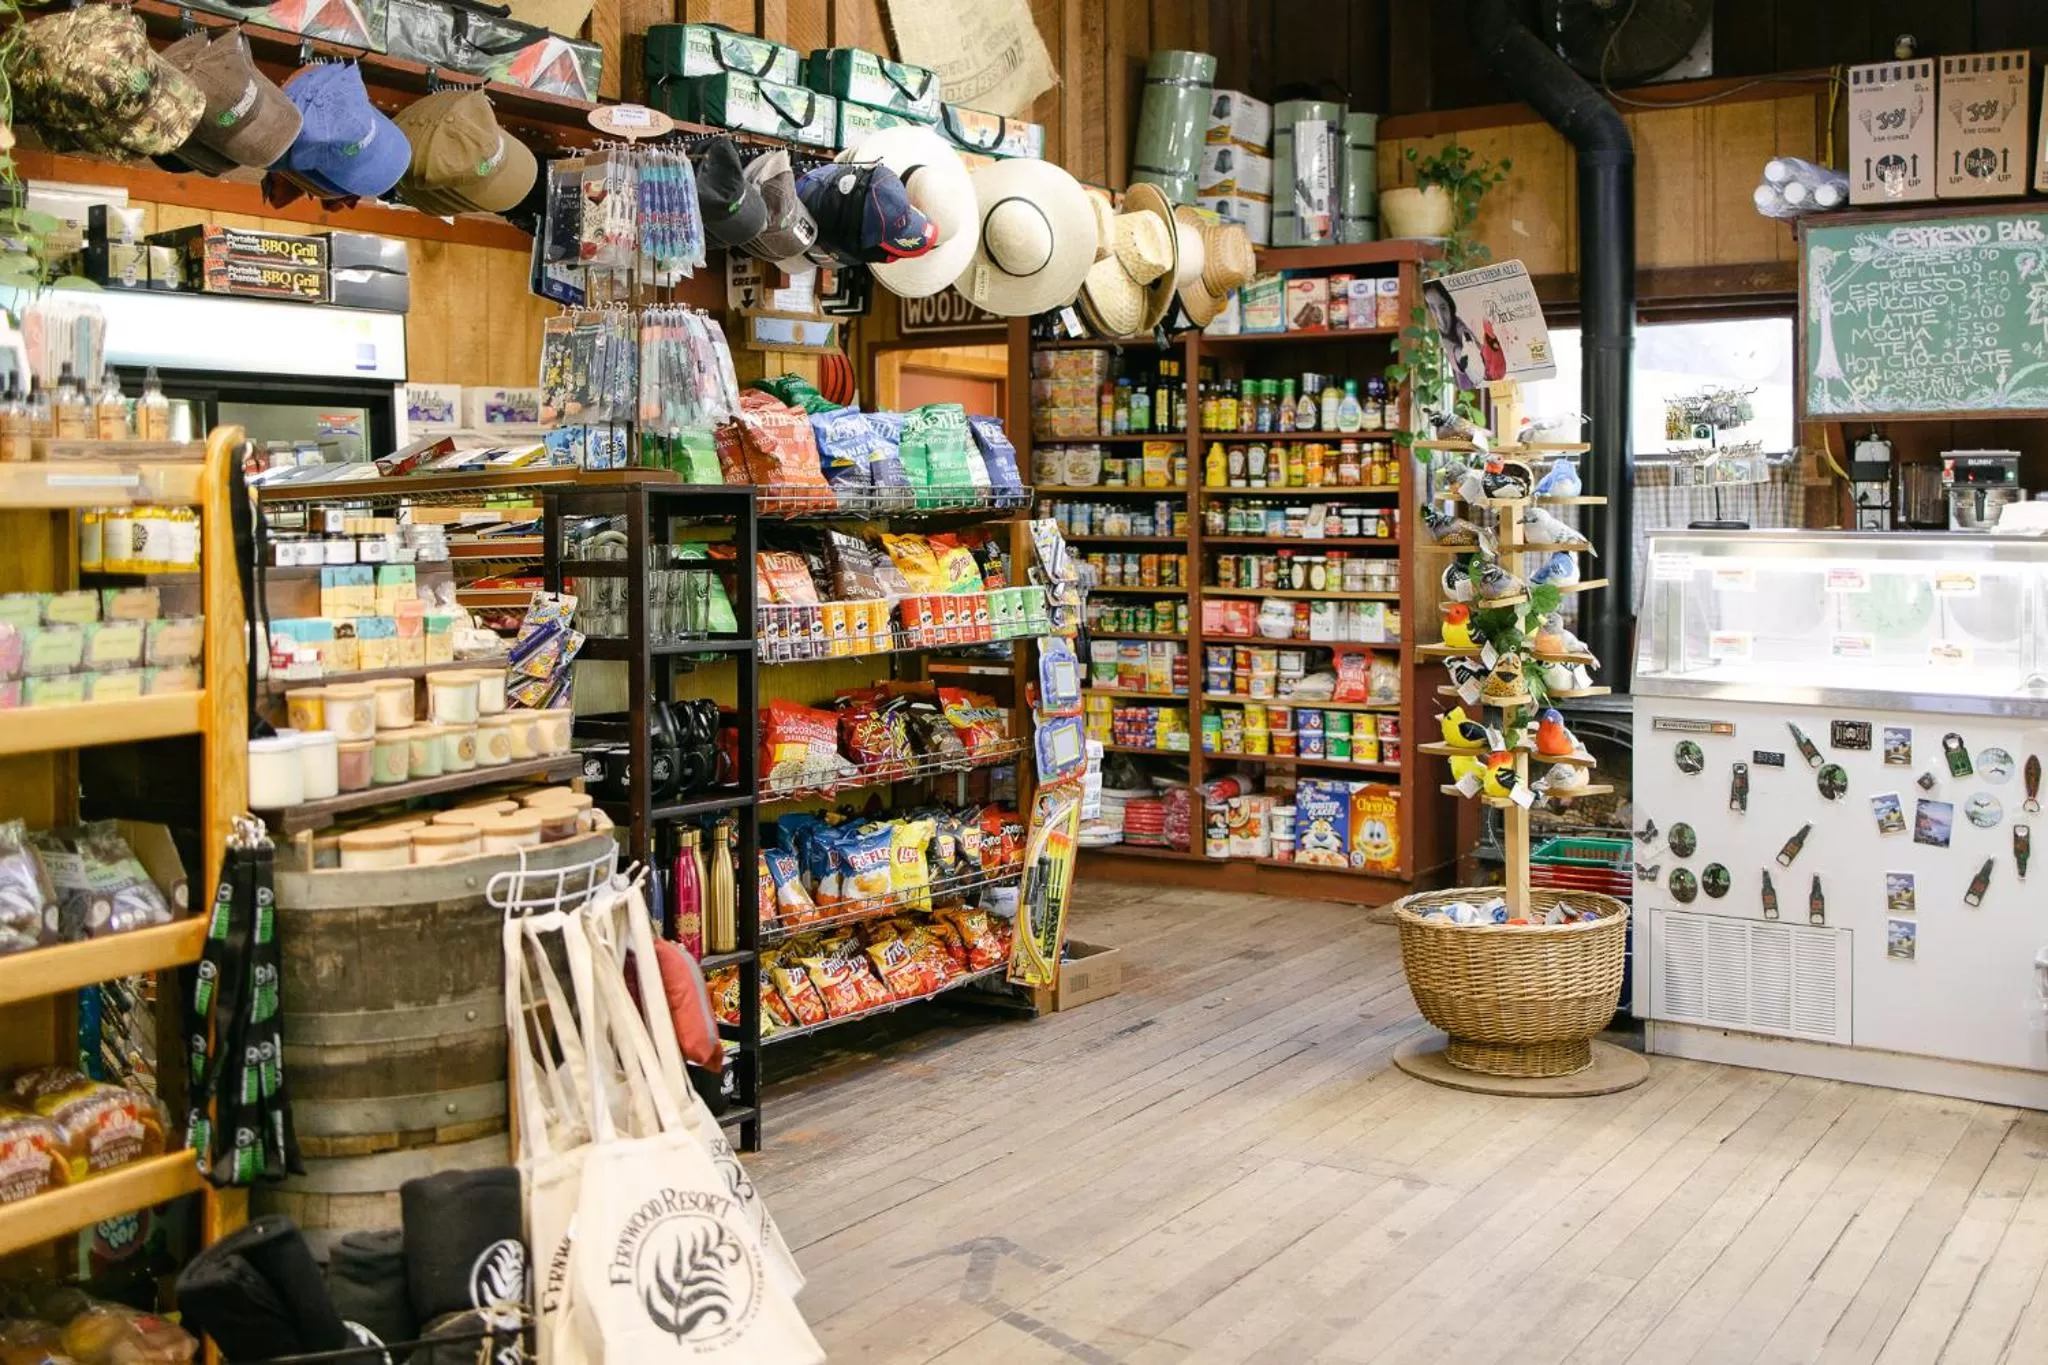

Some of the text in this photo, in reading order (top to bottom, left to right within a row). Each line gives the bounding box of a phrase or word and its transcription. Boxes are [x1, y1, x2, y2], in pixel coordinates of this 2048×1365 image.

[1862, 182, 1876, 191] UP
[1908, 178, 1922, 188] UP
[1950, 176, 1964, 185] UP
[1998, 173, 2012, 183] UP
[1892, 219, 2045, 248] ESPRESSO BAR
[261, 238, 290, 257] BBQ
[291, 242, 318, 258] Grill
[1872, 251, 1957, 269] COFFEE
[732, 264, 748, 275] ICE
[1888, 266, 1947, 280] REFILL
[263, 270, 292, 288] BBQ
[293, 272, 320, 288] Grill
[1848, 277, 1967, 300] ESPRESSO
[1831, 293, 1949, 317] CAPPUCCINO
[1867, 309, 1940, 329] LATTE
[1851, 326, 1934, 346] MOCHA
[1873, 340, 1928, 357] TEA
[1844, 348, 2013, 374] HOT CHOCOLATE
[1883, 366, 1945, 382] DOUBLE
[608, 1187, 731, 1287] FERNWOOD RESORT
